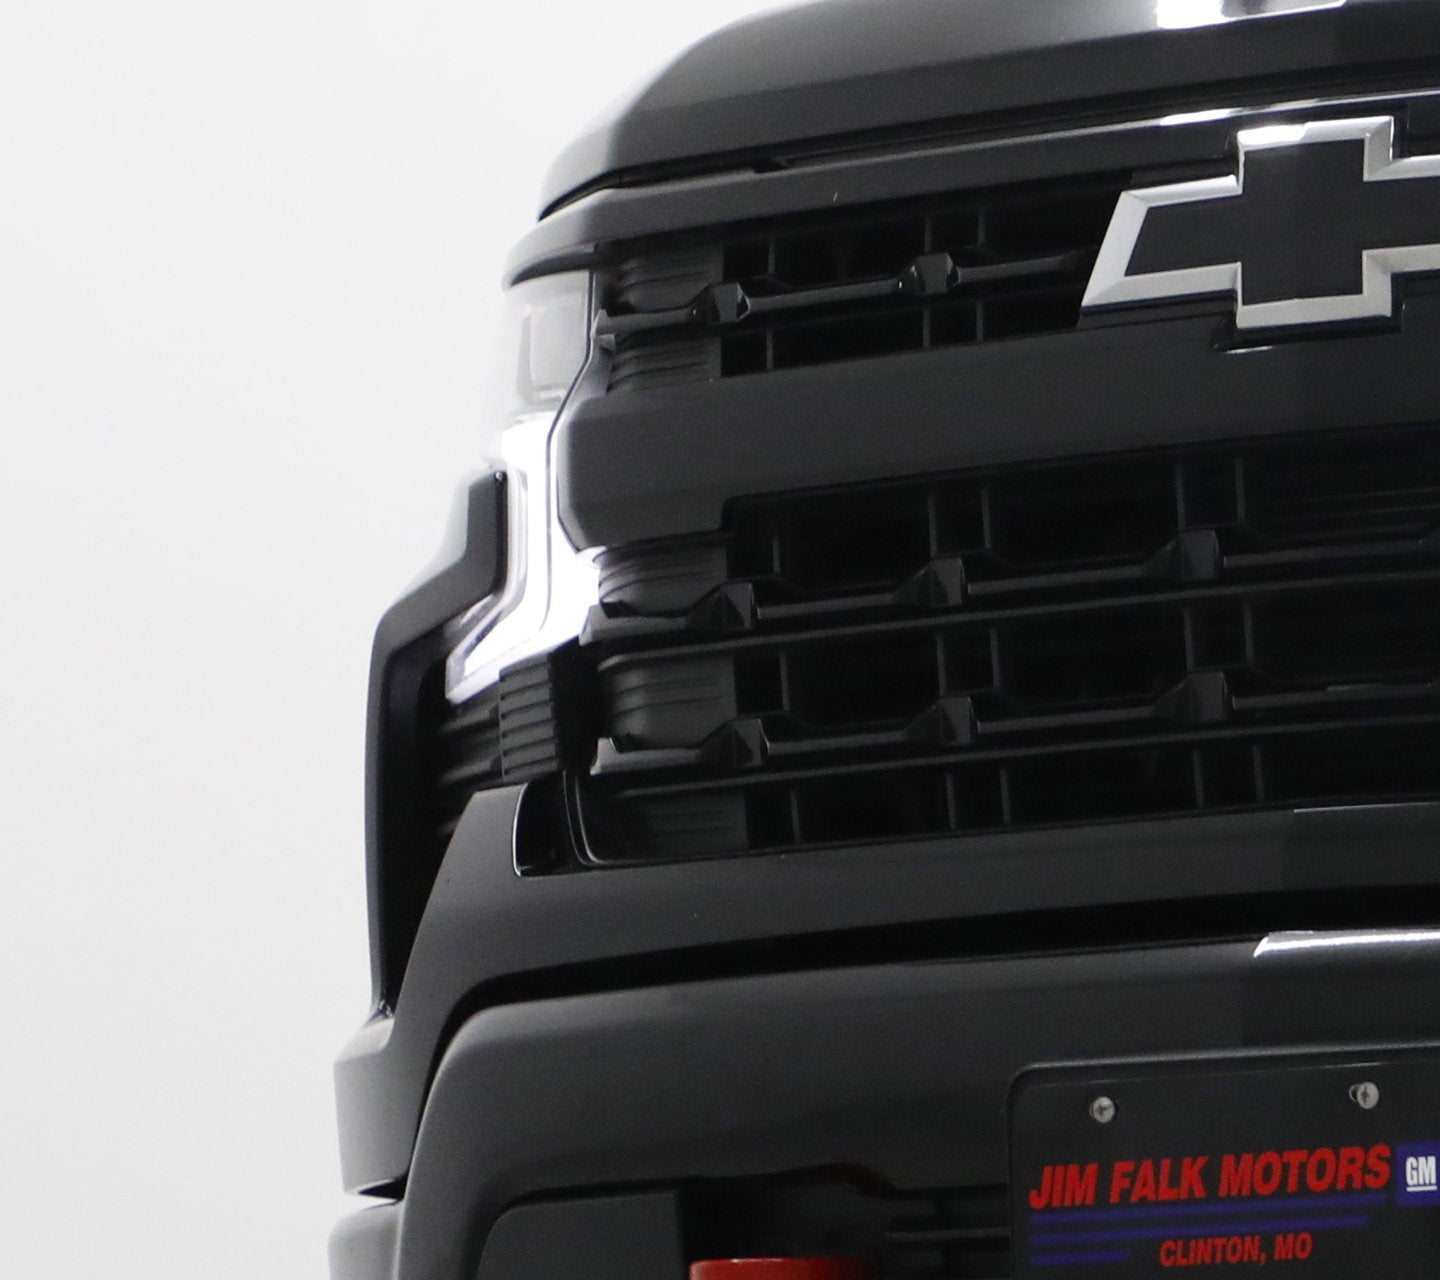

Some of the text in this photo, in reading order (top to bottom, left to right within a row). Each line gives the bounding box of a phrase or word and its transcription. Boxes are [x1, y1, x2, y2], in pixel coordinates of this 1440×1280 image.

[1029, 1144, 1392, 1209] JIM FALK MOTORS
[1406, 1156, 1437, 1192] GM
[1160, 1232, 1313, 1266] CLINTON, MO
